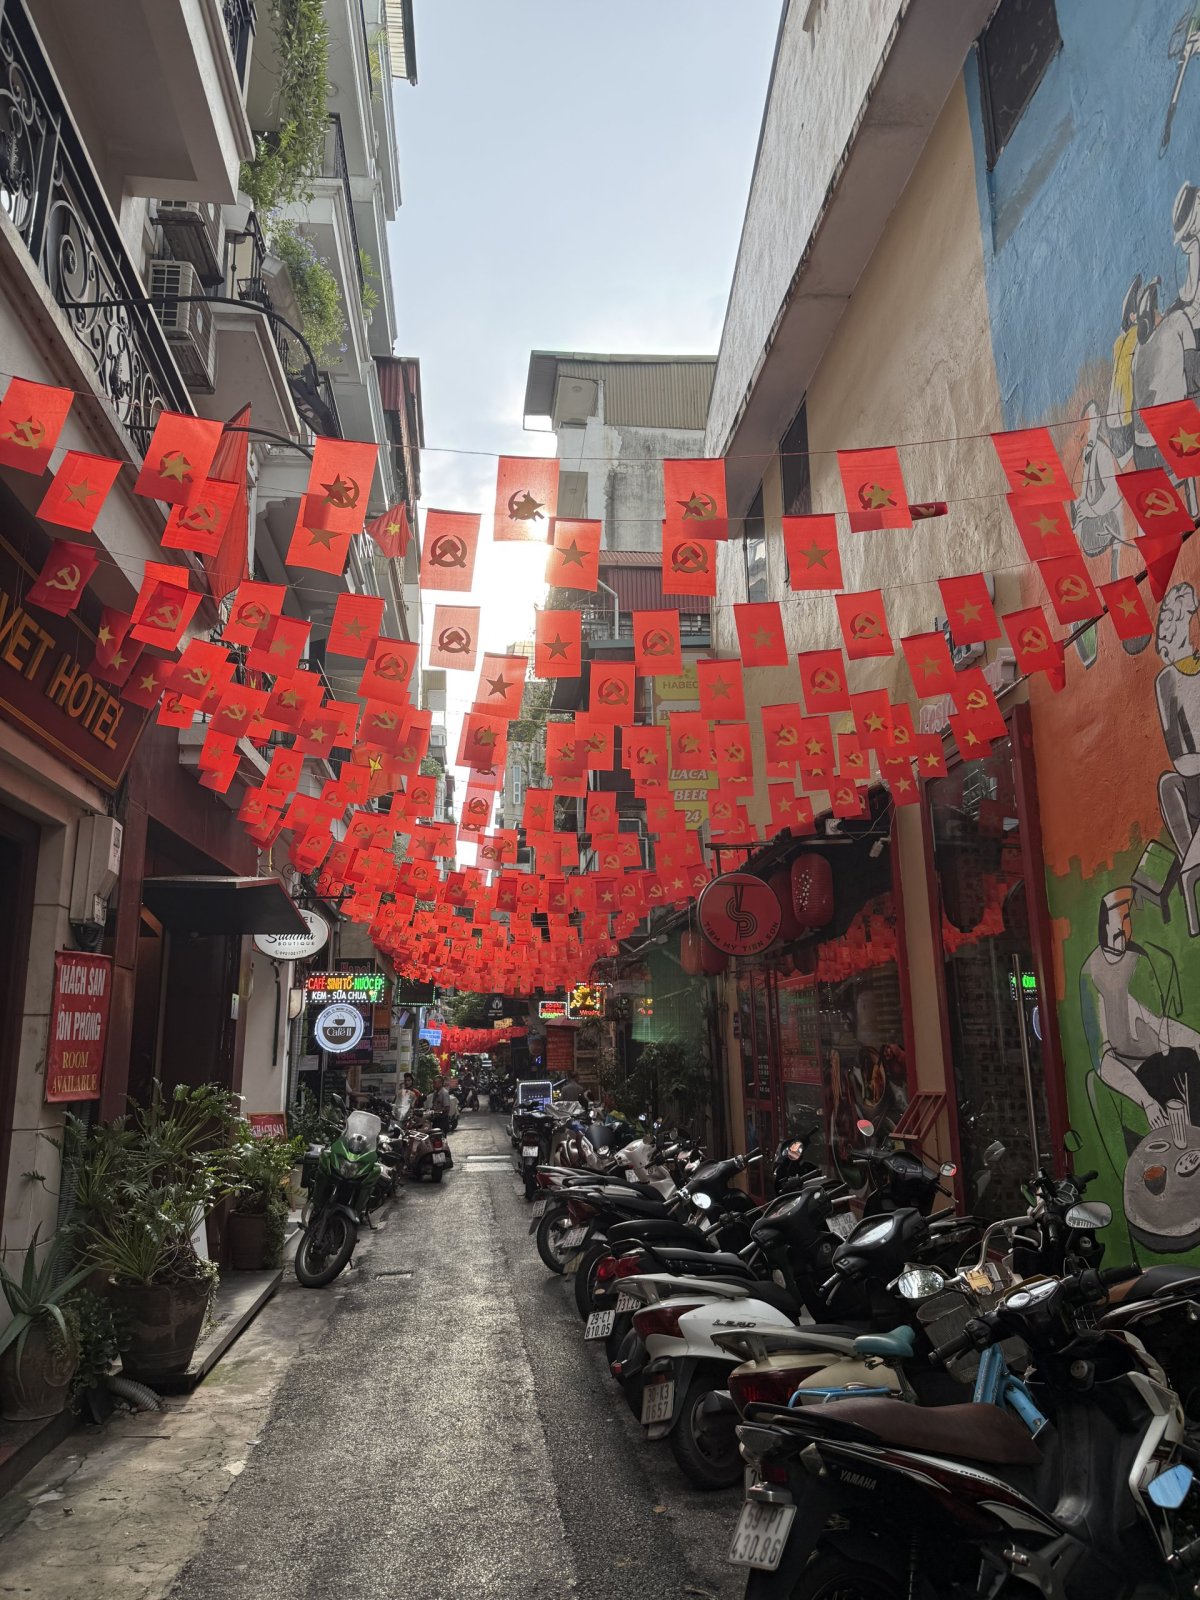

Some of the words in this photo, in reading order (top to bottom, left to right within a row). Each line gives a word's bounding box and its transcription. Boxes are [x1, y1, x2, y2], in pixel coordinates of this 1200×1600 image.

[663, 681, 699, 689] HABEC
[46, 652, 124, 751] HOTEL
[674, 790, 708, 801] BEER
[685, 810, 702, 822] 24
[312, 991, 326, 1000] KEM
[347, 991, 367, 1000] CHUA
[73, 1005, 101, 1041] PHÒNG
[62, 1051, 89, 1069] ROOM
[51, 1073, 97, 1094] AVAILABLE
[590, 1311, 612, 1325] 29-C1
[712, 1319, 757, 1328] LEAD
[839, 1469, 878, 1491] YAMAHA
[745, 1505, 786, 1535] 59-P1
[731, 1533, 781, 1564] 430.86
